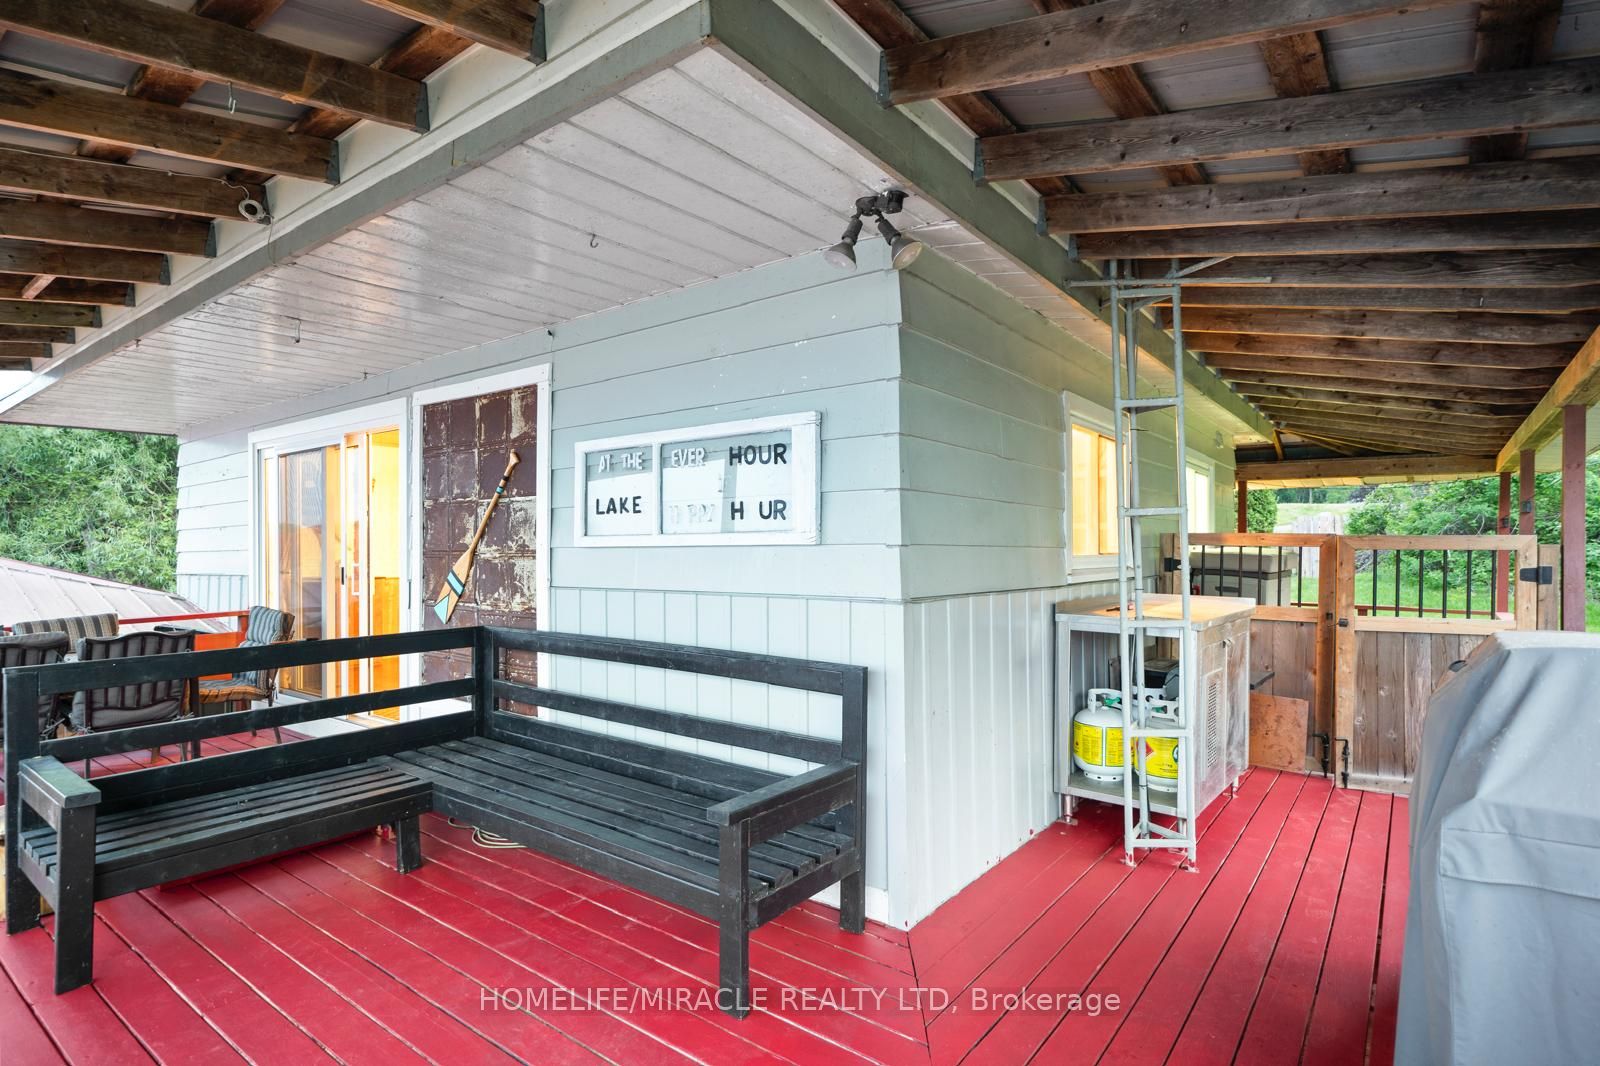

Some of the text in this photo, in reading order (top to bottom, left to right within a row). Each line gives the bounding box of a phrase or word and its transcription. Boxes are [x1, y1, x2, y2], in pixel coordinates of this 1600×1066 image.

[598, 451, 643, 473] AT THE
[671, 443, 787, 468] EVER HOUR
[595, 495, 642, 515] LAKE
